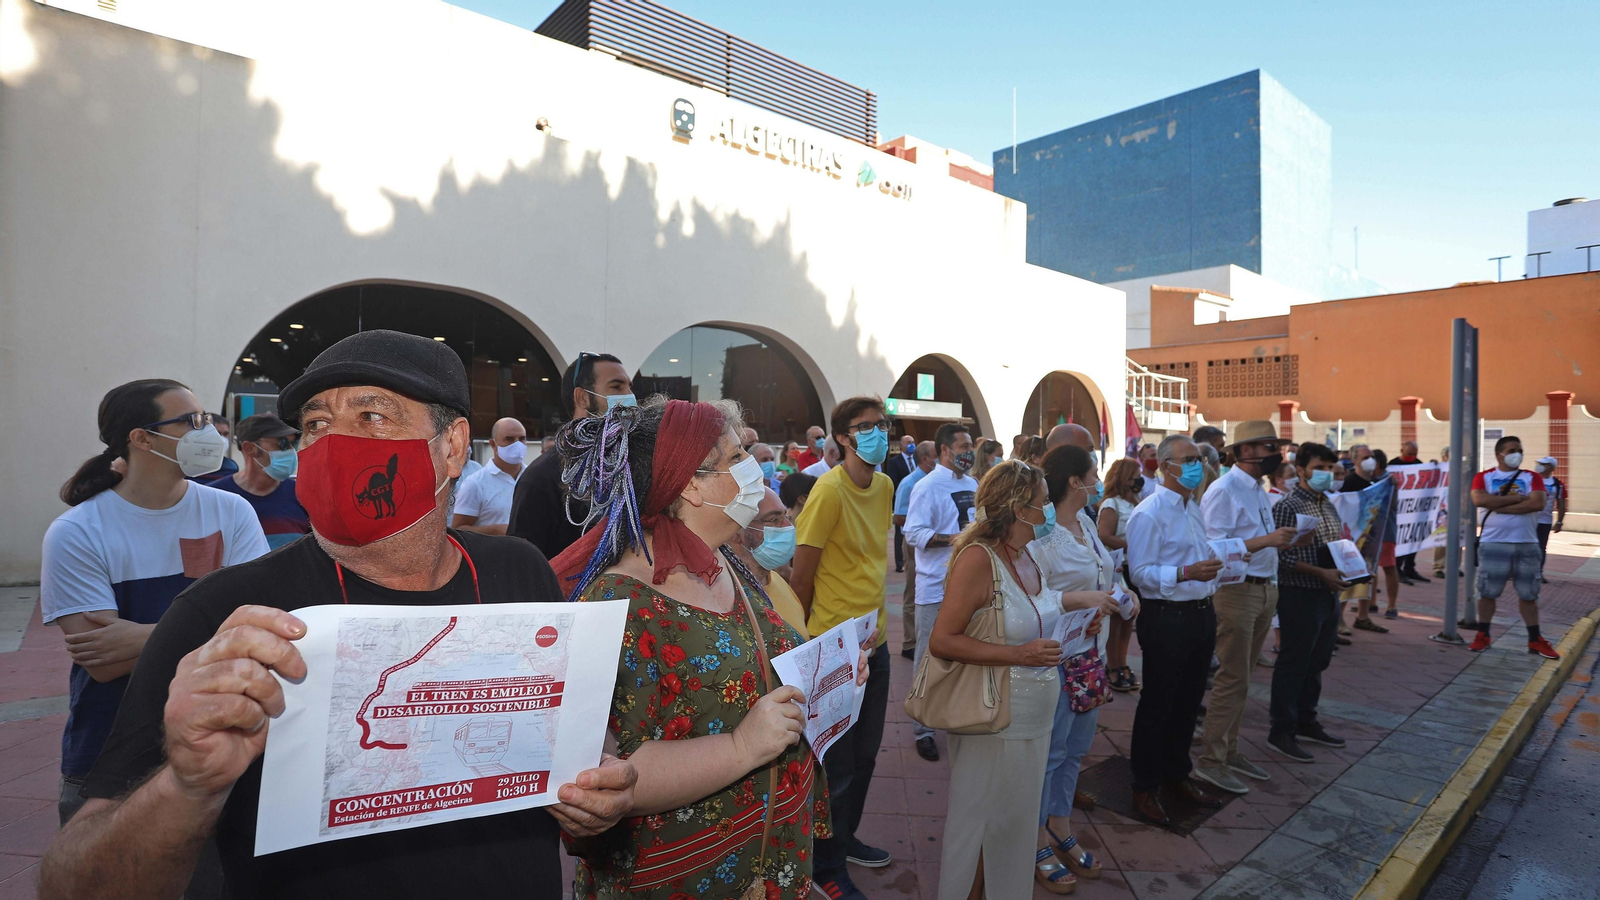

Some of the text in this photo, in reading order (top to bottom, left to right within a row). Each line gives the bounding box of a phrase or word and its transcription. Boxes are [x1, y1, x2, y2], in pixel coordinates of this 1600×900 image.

[710, 115, 842, 180] ALGECIRAS
[371, 485, 390, 496] CGT
[411, 684, 554, 702] EL TREN ES EMPLEO Y
[376, 698, 551, 718] DESARROLLO SOSTENIBLE
[498, 773, 540, 787] 29 JULIO
[335, 781, 474, 814] CONCENTRACIÓN
[496, 782, 539, 799] 10:30 H
[334, 796, 474, 824] Estación de RENFE de Algeciras
